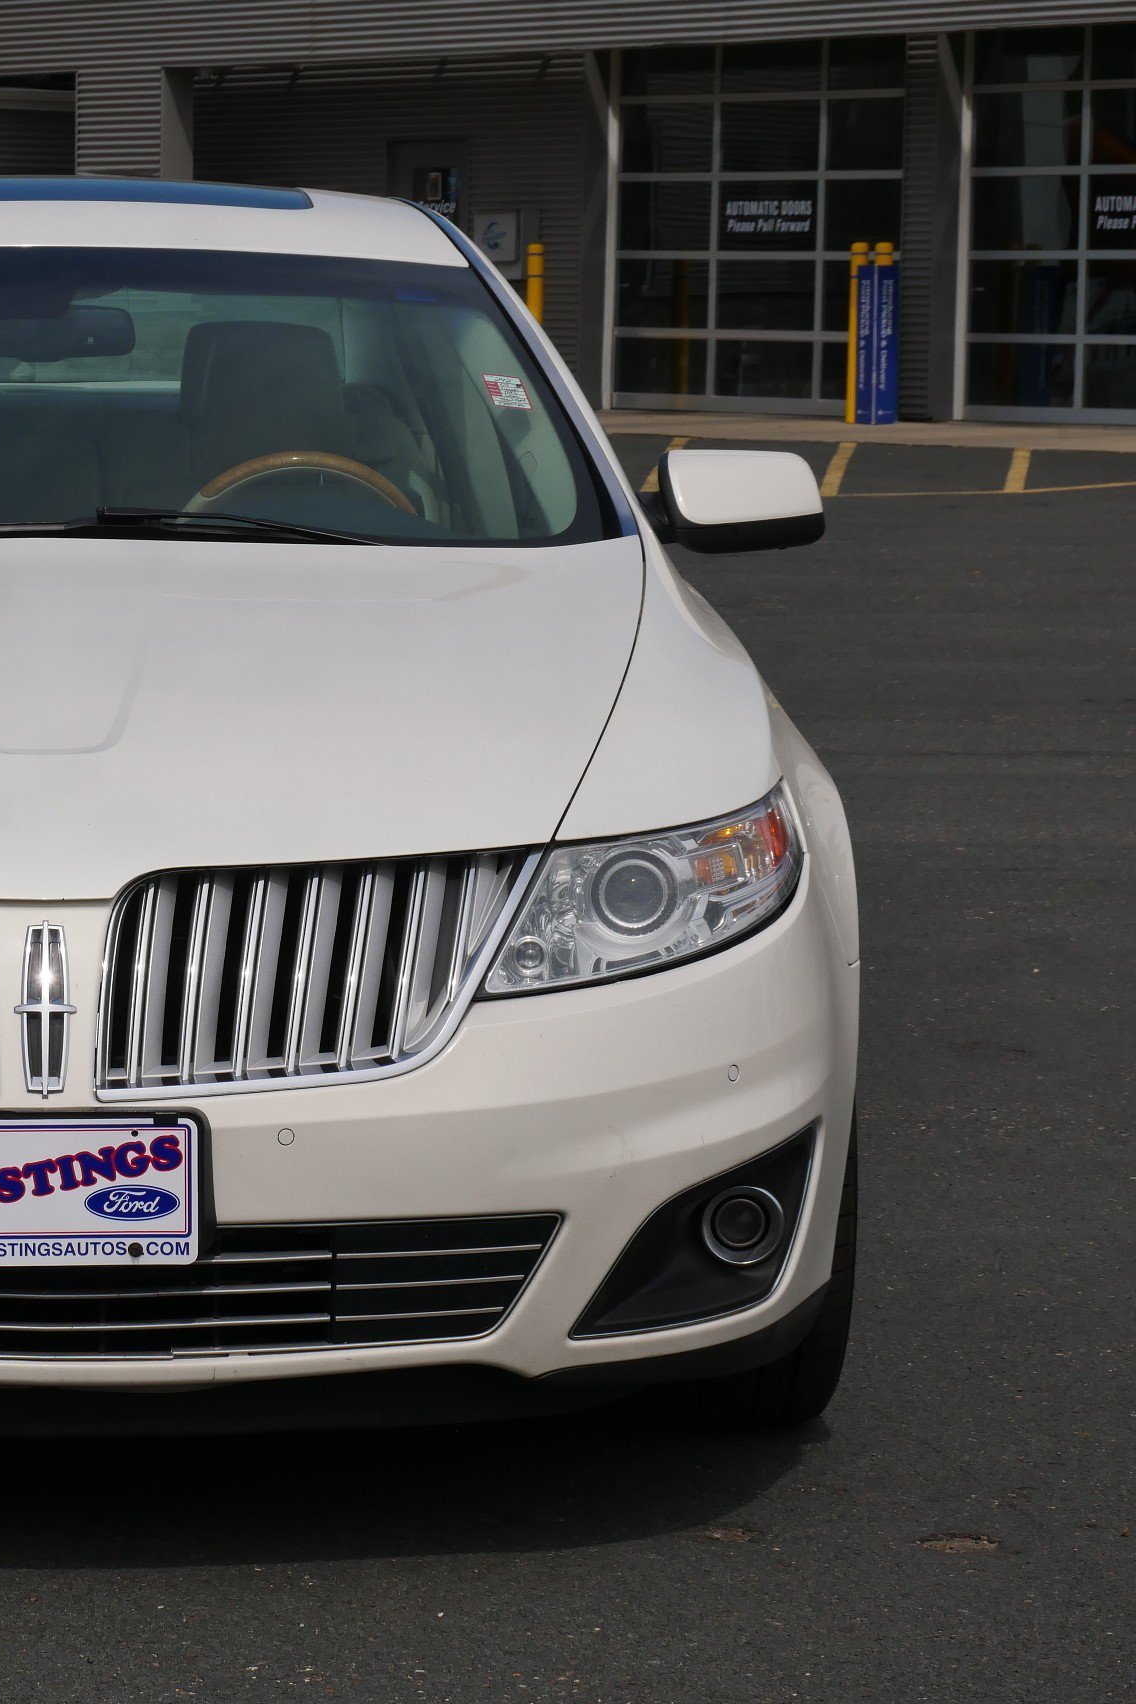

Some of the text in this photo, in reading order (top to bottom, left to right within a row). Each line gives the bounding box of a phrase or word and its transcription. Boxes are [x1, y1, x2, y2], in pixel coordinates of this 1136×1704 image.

[725, 200, 813, 216] AUTOMATIC DOORS
[727, 218, 811, 232] Please Pull Forward
[1096, 215, 1129, 230] Please
[103, 1190, 161, 1213] Ford
